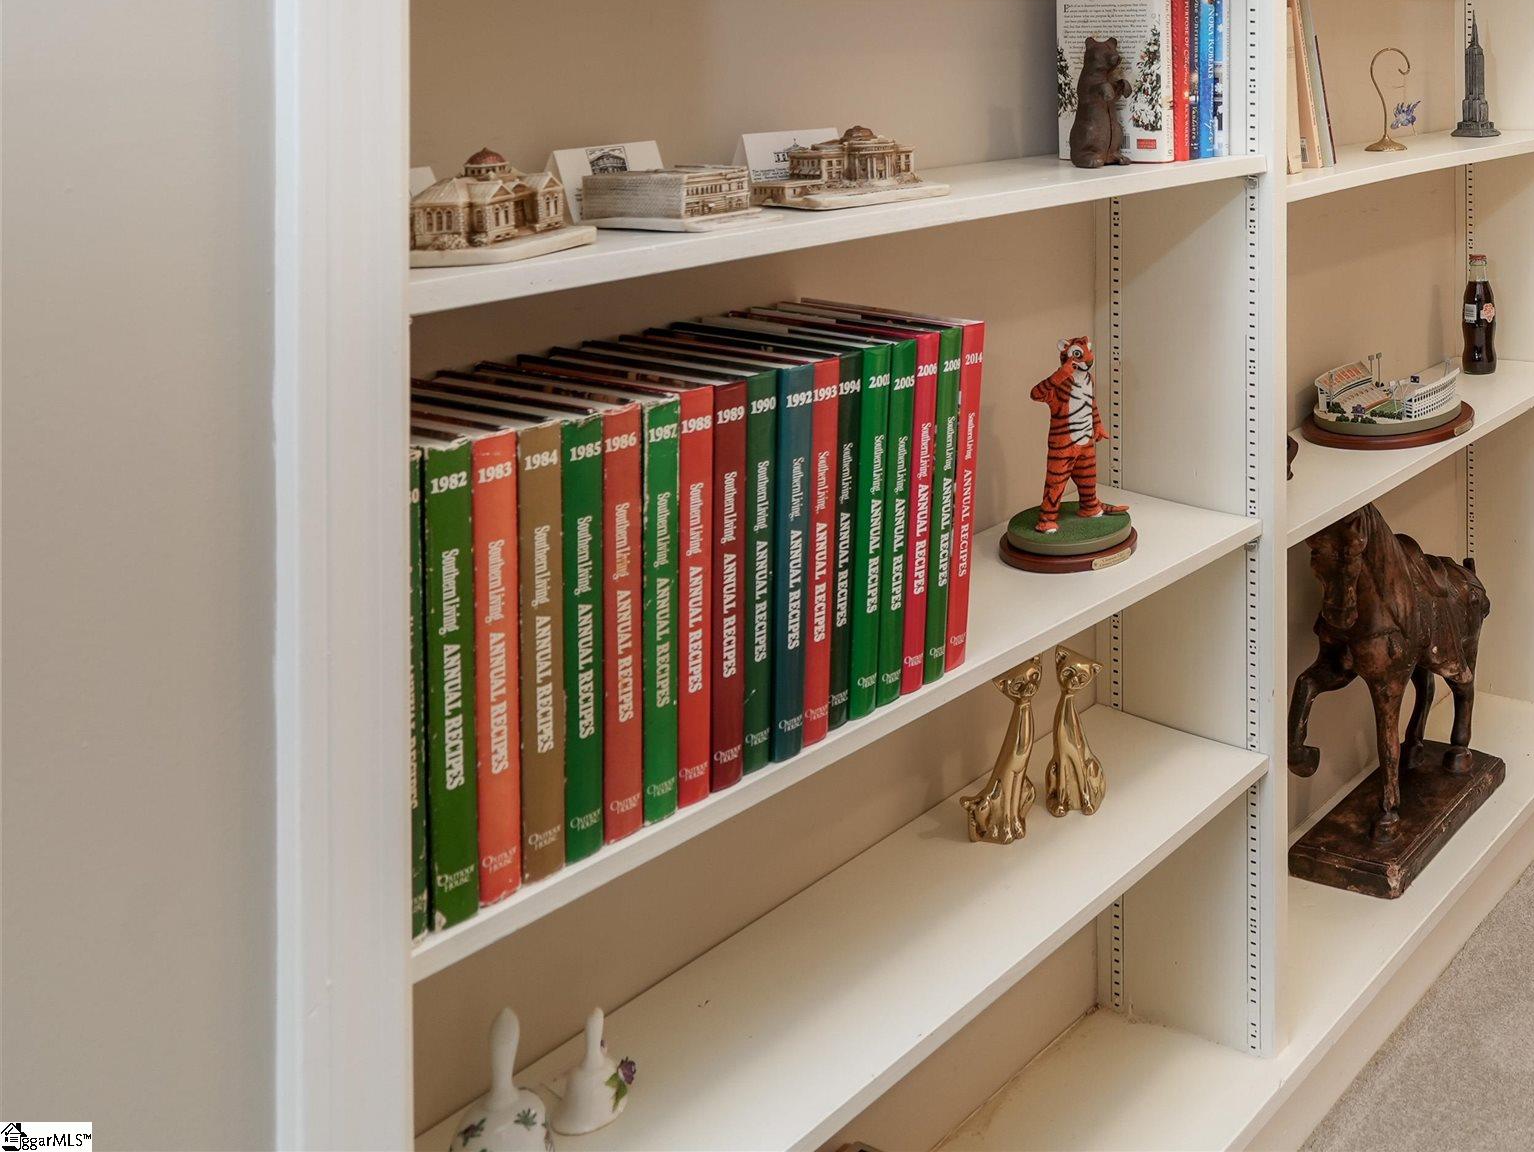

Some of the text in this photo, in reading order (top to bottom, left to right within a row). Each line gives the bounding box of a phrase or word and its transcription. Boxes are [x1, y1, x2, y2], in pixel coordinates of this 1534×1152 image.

[838, 379, 861, 396] 1994
[894, 375, 914, 391] 2005
[917, 364, 938, 378] 2006
[965, 352, 984, 366] 2014
[716, 406, 745, 424] 1989
[750, 396, 776, 415] 1990
[786, 390, 813, 408] 1992
[813, 385, 838, 402] 1993
[570, 441, 602, 462] 1985
[604, 432, 637, 453] 1986
[648, 424, 678, 443] 1987
[681, 416, 712, 434] 1988
[430, 471, 468, 494] 1982
[478, 461, 512, 484] 1983
[524, 449, 558, 470] 1984
[916, 484, 930, 537] ANNUAL
[940, 478, 953, 530] ANNUAL
[962, 469, 973, 521] ANNUAL
[814, 522, 828, 580] ANNUAL
[838, 512, 851, 568] ANNUAL
[868, 498, 882, 554] ANNUAL
[893, 498, 906, 552] ANNUAL
[958, 523, 970, 578] RECIPES
[723, 553, 736, 614] ANNUAL
[756, 540, 768, 600] ANNUAL
[789, 530, 802, 588] ANNUAL
[866, 557, 880, 614] RECIPES
[890, 554, 904, 611] RECIPES
[914, 541, 928, 595] RECIPES
[938, 532, 950, 587] RECIPES
[616, 590, 632, 654] ANNUAL
[656, 578, 670, 641] ANNUAL
[688, 566, 703, 628] ANNUAL
[787, 590, 802, 650] RECIPES
[814, 582, 827, 642] RECIPES
[836, 568, 849, 628] RECIPES
[536, 616, 552, 683] ANNUAL
[578, 604, 594, 669] ANNUAL
[722, 614, 736, 678] RECIPES
[754, 600, 768, 663] RECIPES
[443, 644, 462, 715] ANNUAL
[489, 632, 507, 703] ANNUAL
[618, 656, 634, 723] RECIPES
[656, 642, 670, 708] RECIPES
[688, 628, 702, 694] RECIPES
[536, 682, 554, 753] RECIPES
[578, 668, 595, 740] RECIPES
[444, 714, 465, 790] RECIPES
[490, 701, 510, 774] RECIPES
